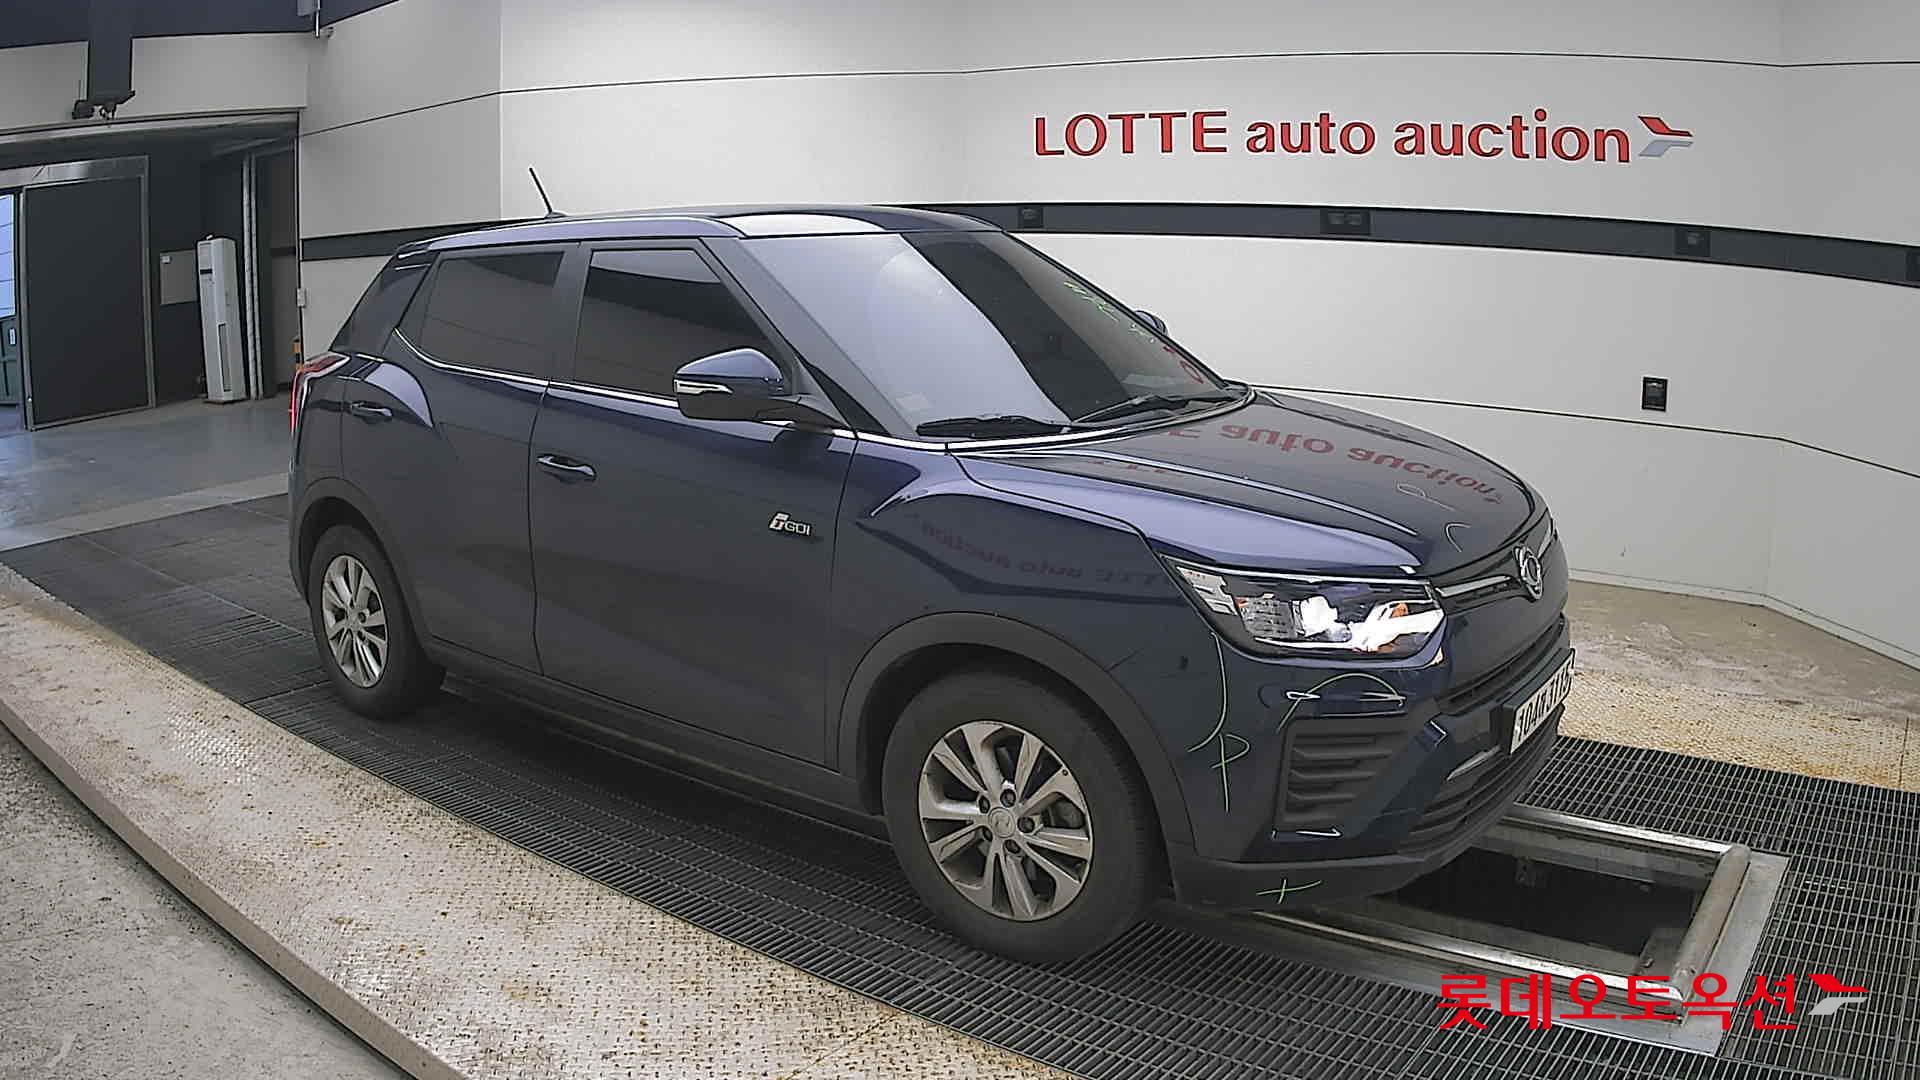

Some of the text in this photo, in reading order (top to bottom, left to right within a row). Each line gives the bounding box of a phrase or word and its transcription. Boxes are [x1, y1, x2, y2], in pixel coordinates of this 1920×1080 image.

[1035, 109, 1630, 163] LOTTE auto auction
